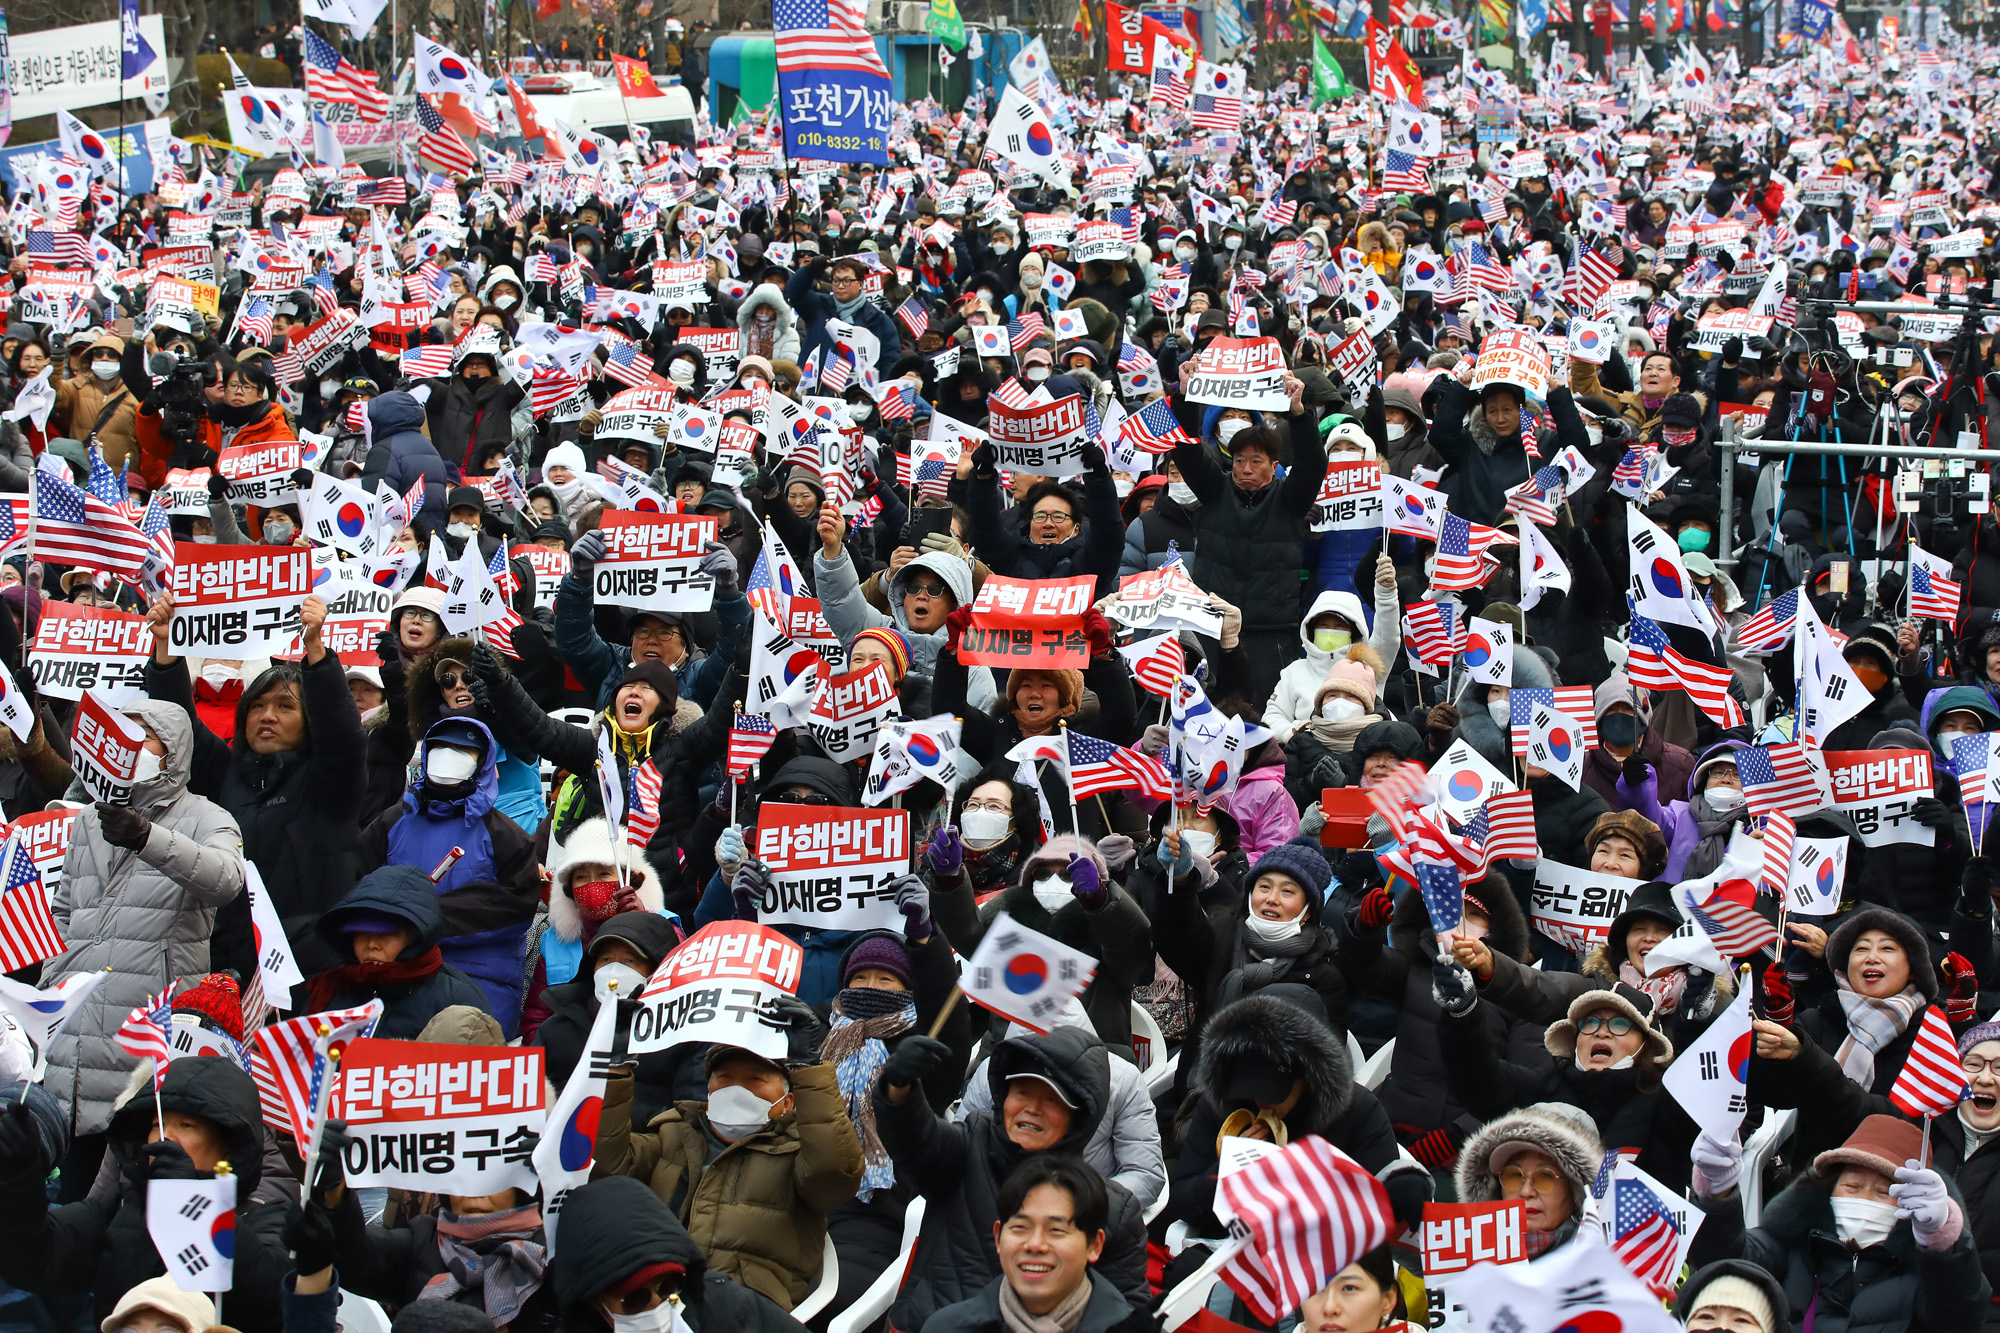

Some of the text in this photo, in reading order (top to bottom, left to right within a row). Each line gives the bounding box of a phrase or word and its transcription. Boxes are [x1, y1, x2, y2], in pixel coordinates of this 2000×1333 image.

[1119, 9, 1144, 67] 경남
[22, 56, 65, 94] 책임으로
[67, 45, 121, 86] 거듭나겠습
[789, 84, 891, 132] 포천가산
[169, 217, 213, 233] 탄핵반대
[1024, 217, 1072, 231] 탄핵반대
[1076, 224, 1122, 242] 탄핵반대
[1695, 225, 1744, 244] 탄핵반대
[166, 236, 192, 246] 이재명
[1076, 243, 1104, 259] 이재명
[1930, 239, 1960, 253] 이재명
[189, 267, 213, 282] 구속
[256, 267, 303, 291] 핵반대
[653, 263, 706, 283] 탄핵반대
[1730, 276, 1757, 290] 재명
[1610, 281, 1637, 295] 반대
[401, 306, 431, 328] 반대
[1900, 318, 1936, 333] 이재명
[297, 310, 357, 359] 탄핵반대
[1486, 331, 1515, 351] 탄핵
[1519, 335, 1546, 363] 반대
[310, 342, 344, 373] 이재명
[1201, 343, 1287, 374] 탄핵반대
[1332, 329, 1373, 379] 반대
[1477, 351, 1550, 380] 부정선거 OUT
[1188, 376, 1251, 398] 이재명
[1476, 366, 1511, 384] 이재명
[1516, 369, 1540, 391] 구속
[595, 413, 635, 434] 이재명
[990, 398, 1081, 442] 탄핵반대
[720, 425, 758, 452] 반대
[219, 445, 300, 481] 탄핵반대
[991, 445, 1044, 467] 이재명
[167, 488, 209, 508] 이재명
[225, 479, 267, 501] 이재명
[1358, 497, 1383, 519] 구
[603, 519, 715, 559] 탄핵반대
[533, 551, 571, 575] 반대
[172, 552, 309, 604] 탄핵반대
[597, 565, 713, 598] 이재명 구속
[972, 584, 1092, 616] 탄핵 반대
[1117, 592, 1177, 622] 이재명
[37, 618, 151, 653] 탄핵반대
[171, 604, 304, 648] 이재명 구속
[963, 627, 1088, 656] 이재명 구속
[32, 660, 148, 690] 이재명 구속
[76, 711, 139, 778] 탄핵
[266, 796, 287, 806] FILA
[1883, 800, 1914, 824] 구
[759, 815, 909, 865] 탄핵반대
[762, 869, 897, 914] 이재명 구속
[650, 932, 800, 990] 탄핵반대
[634, 988, 723, 1043] 이재명
[344, 1052, 539, 1123] 탄핵반대
[346, 1125, 537, 1177] 이재명 구속
[1424, 1205, 1521, 1271] 반대
